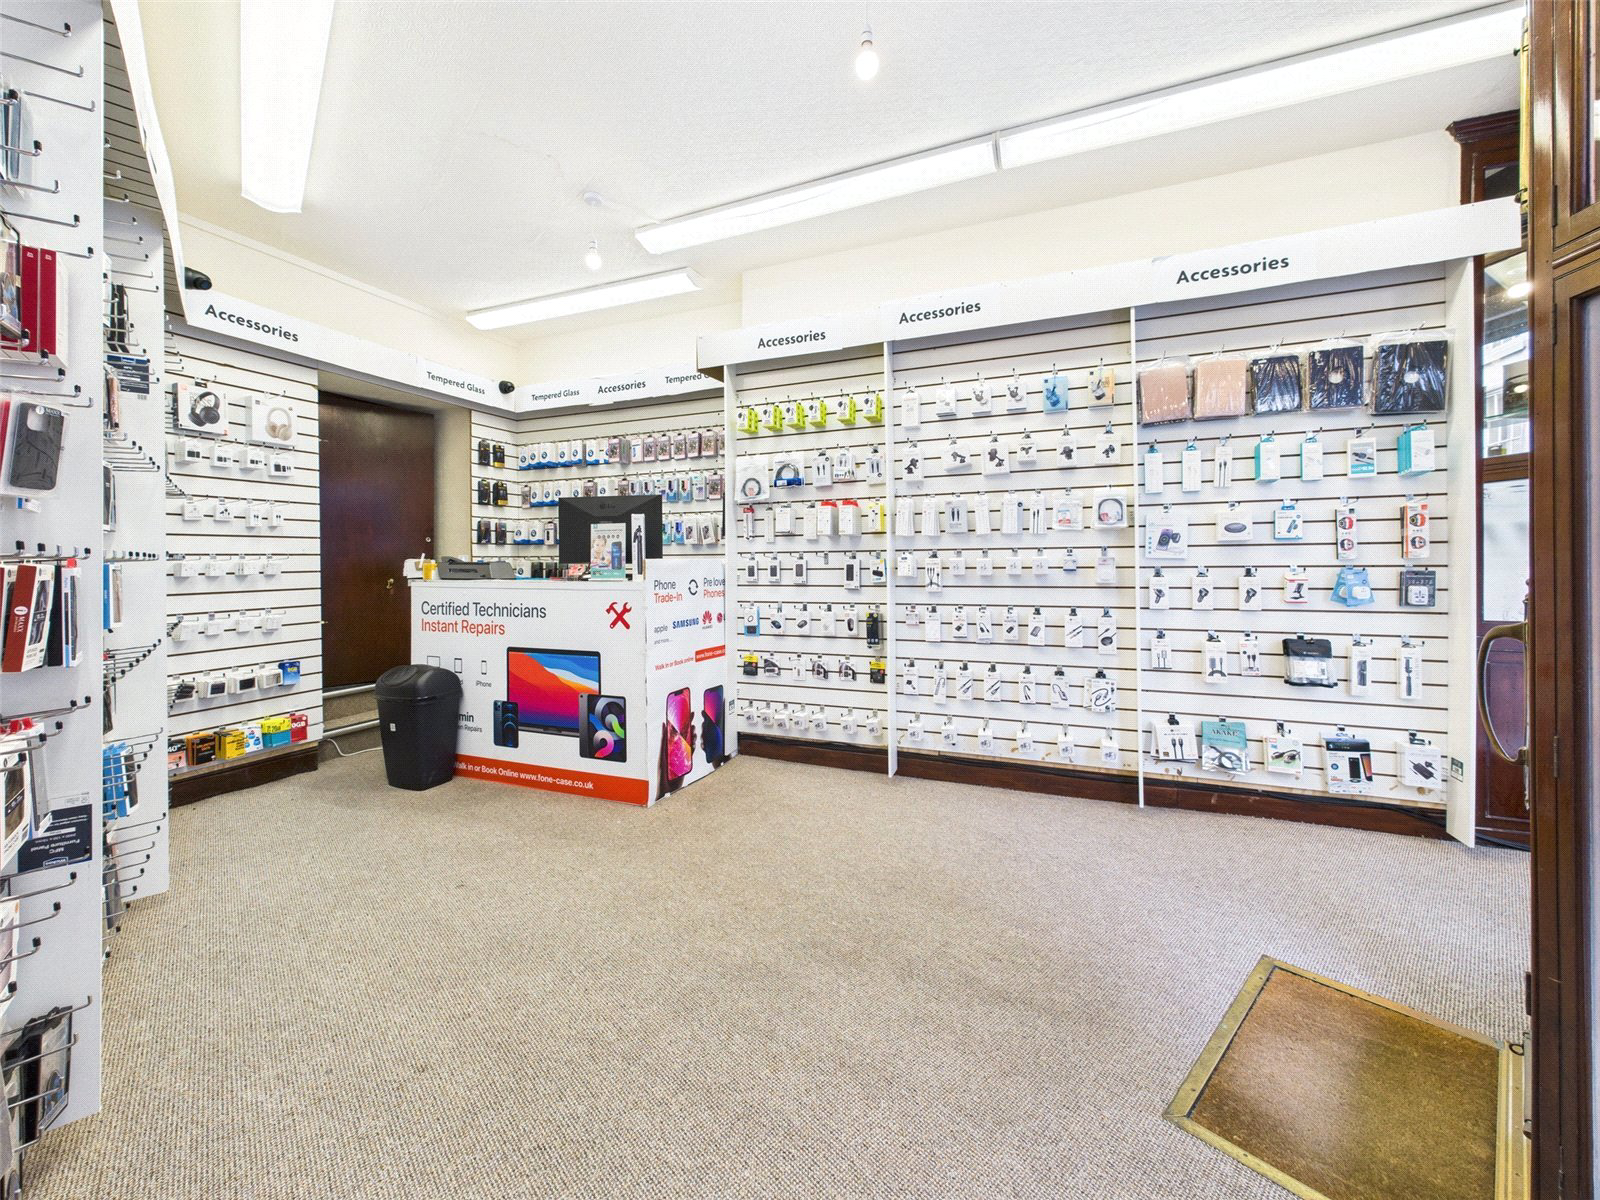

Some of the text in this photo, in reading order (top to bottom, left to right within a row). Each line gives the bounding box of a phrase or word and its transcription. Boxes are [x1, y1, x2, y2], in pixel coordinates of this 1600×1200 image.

[1176, 254, 1290, 285] Accessories
[898, 301, 982, 325] Accessories
[205, 303, 299, 343] Accessories
[757, 330, 826, 349] Accessories
[426, 371, 486, 395] Tempered Glass
[665, 373, 702, 385] Tempered
[597, 379, 646, 395] Accessories
[531, 388, 580, 402] Tempered Glass
[654, 579, 677, 591] Phone
[703, 577, 725, 587] Pre love
[654, 592, 683, 604] Trade-In
[703, 589, 725, 599] Phones
[421, 600, 547, 618] Certified Technicians
[421, 618, 506, 637] Instant Repairs
[653, 624, 669, 634] apple
[672, 617, 700, 630] SAMSUNG
[476, 680, 492, 688] iPhone
[464, 724, 483, 733] Repairs
[468, 762, 474, 771] in
[481, 764, 498, 775] Book
[498, 767, 519, 779] Online
[519, 773, 594, 790] www.fone-case.co.uk
